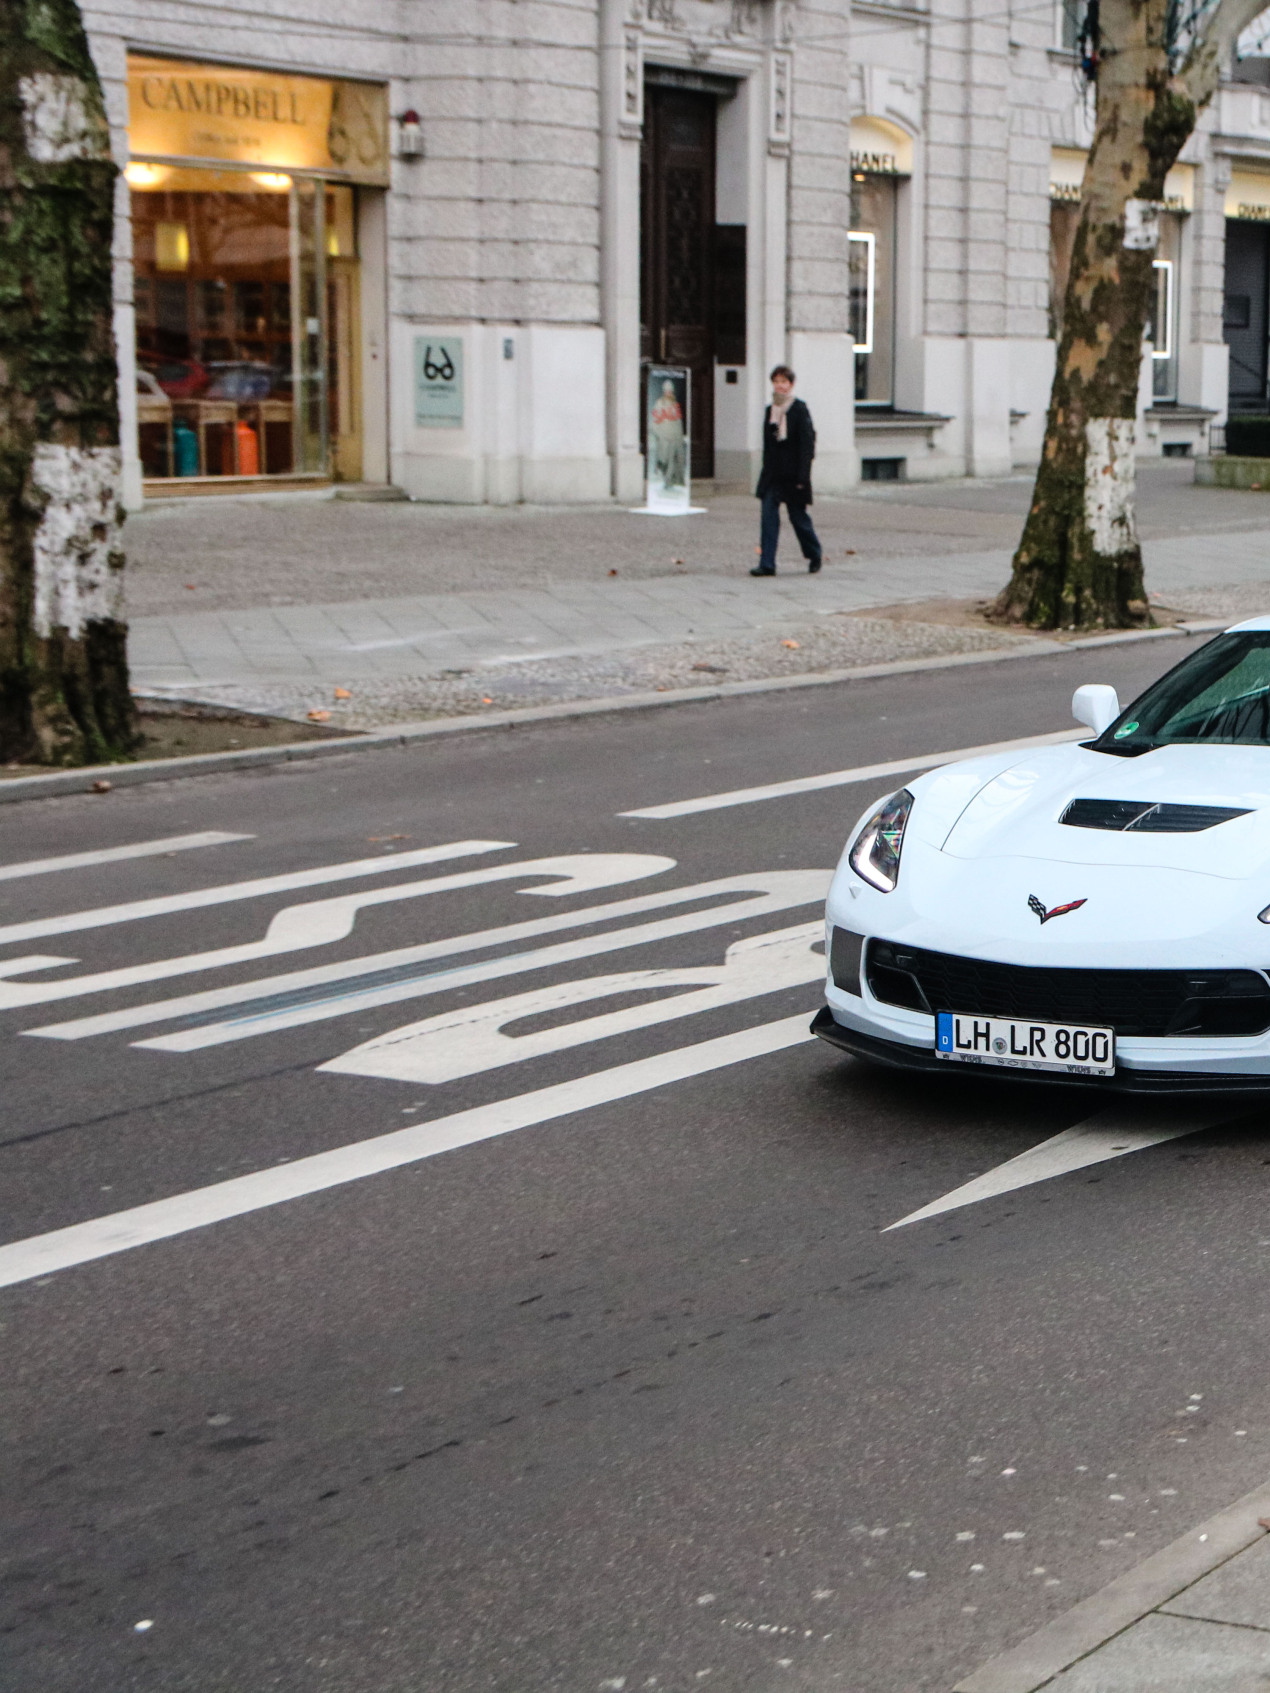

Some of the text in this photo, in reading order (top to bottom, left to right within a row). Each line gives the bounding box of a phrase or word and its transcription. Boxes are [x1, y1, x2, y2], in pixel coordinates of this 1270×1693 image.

[142, 77, 305, 126] CAMPBELL
[850, 151, 898, 174] HANEL
[955, 1018, 990, 1052] LH
[1010, 1024, 1047, 1058] LR
[1054, 1029, 1109, 1063] 800
